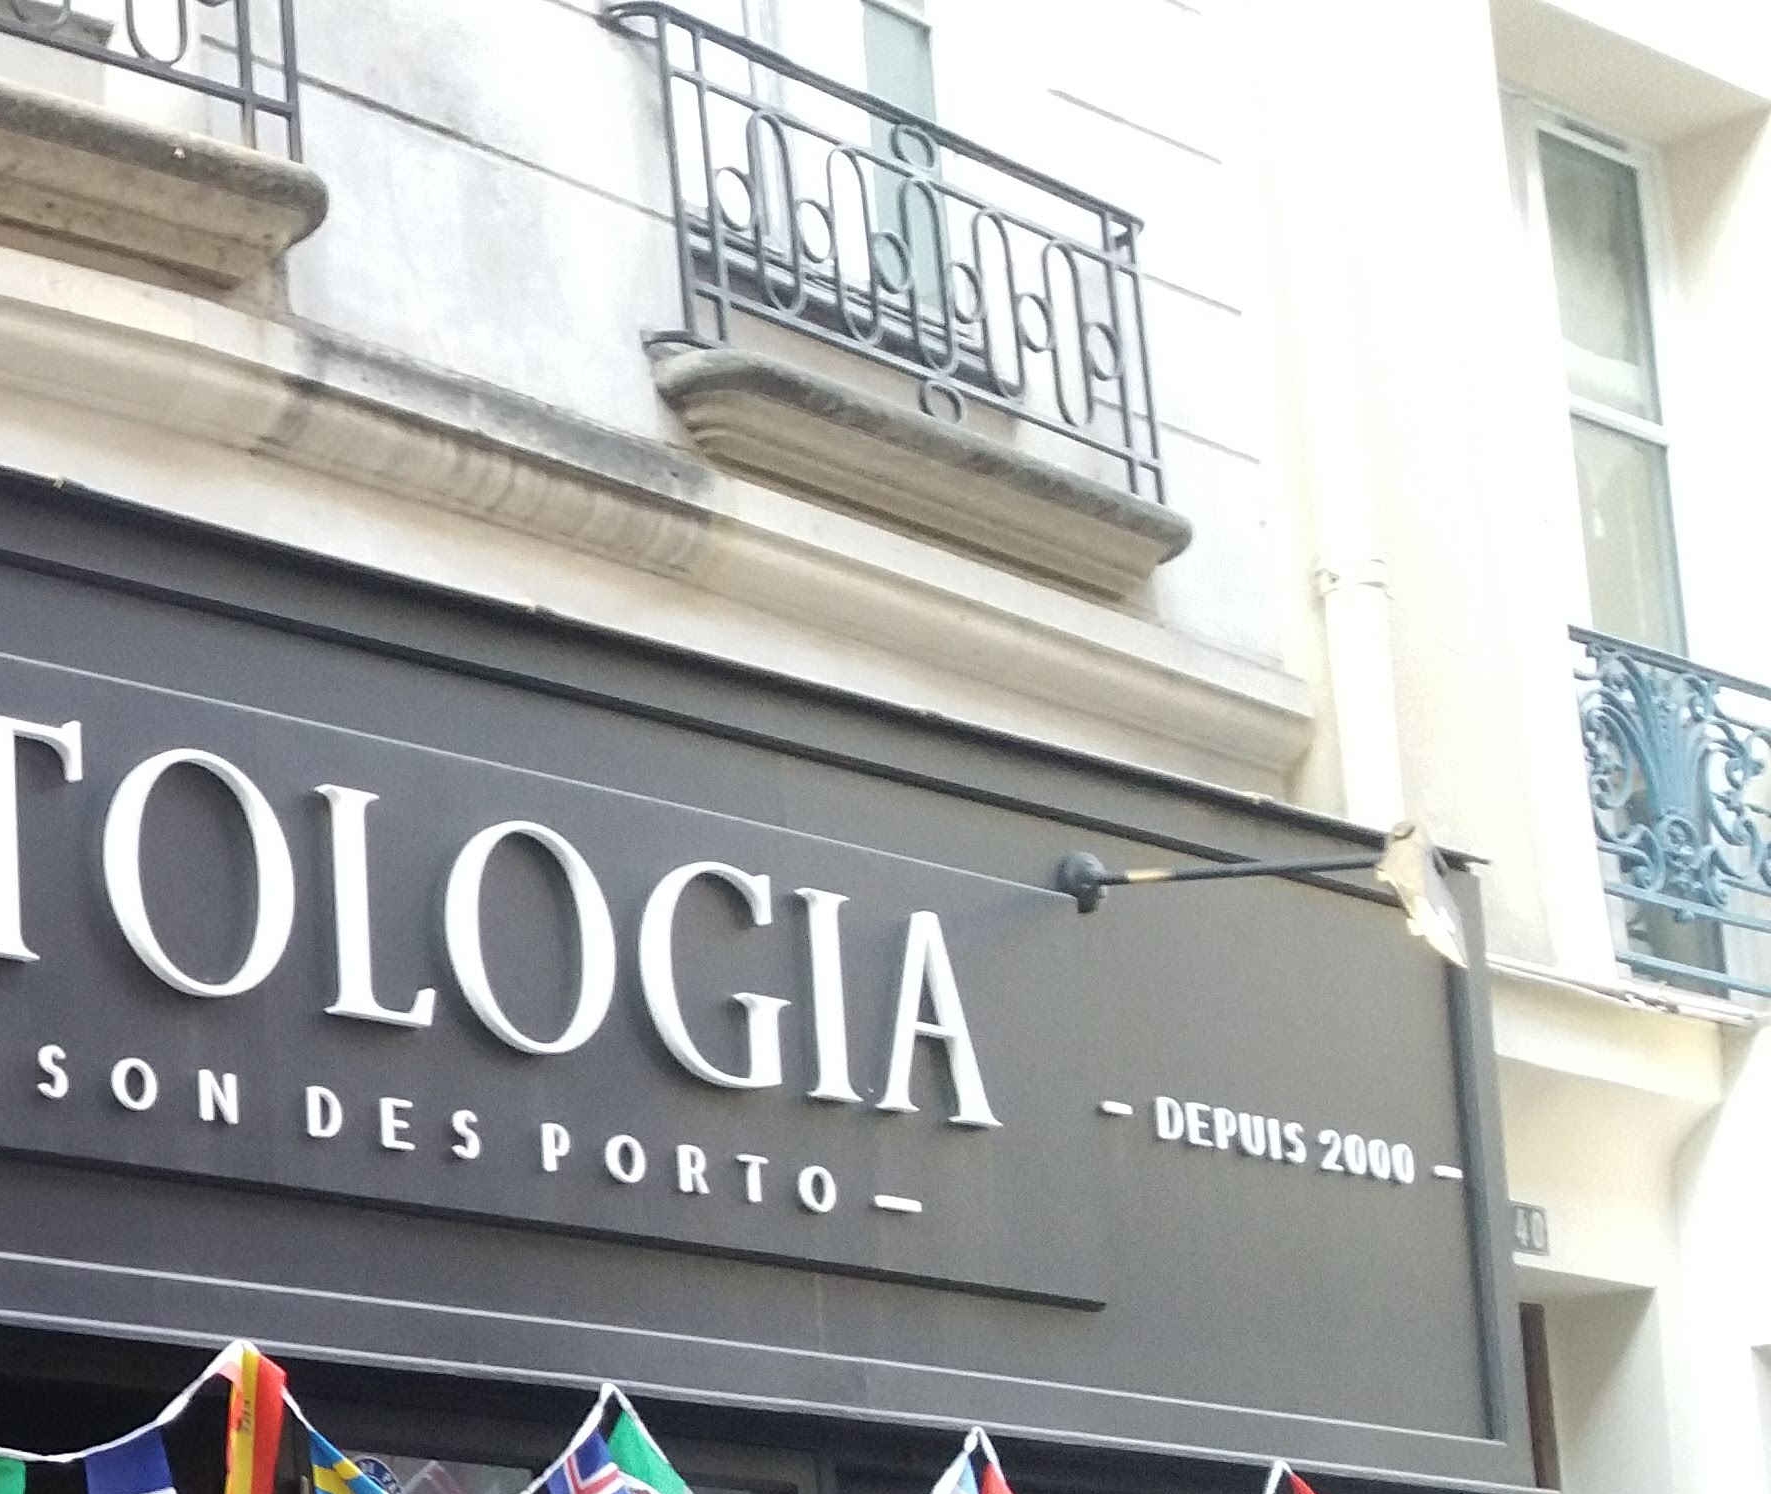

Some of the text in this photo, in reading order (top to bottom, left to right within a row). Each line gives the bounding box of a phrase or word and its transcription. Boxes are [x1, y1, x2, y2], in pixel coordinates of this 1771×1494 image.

[306, 1085, 482, 1160] DES
[540, 1122, 838, 1214] PORTO
[1156, 1096, 1415, 1184] DEPUIS 2000
